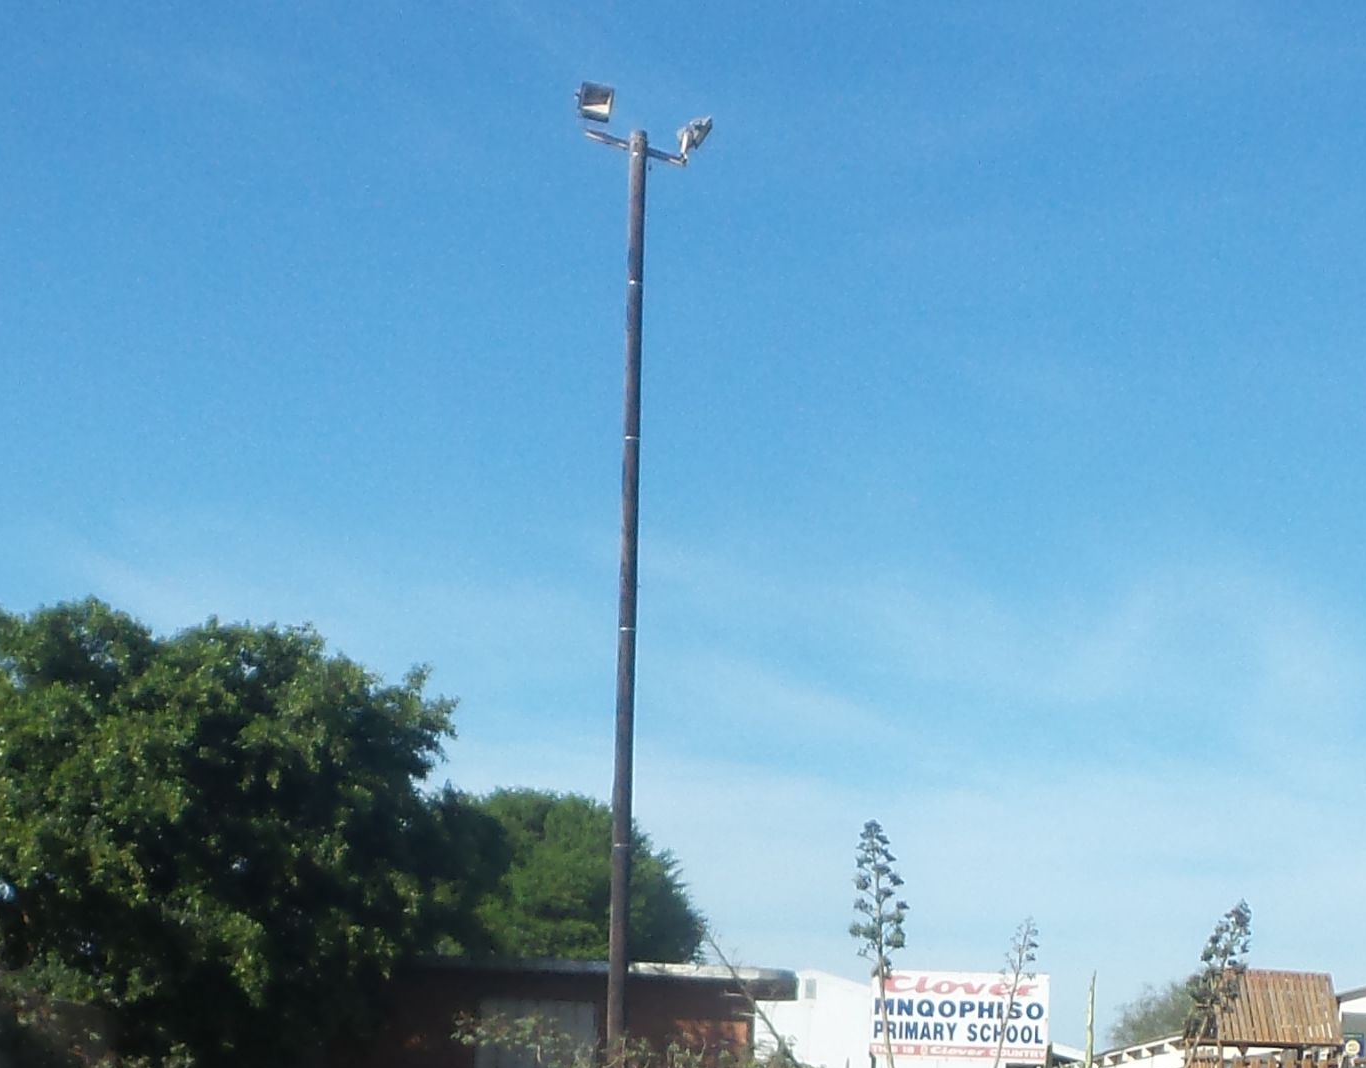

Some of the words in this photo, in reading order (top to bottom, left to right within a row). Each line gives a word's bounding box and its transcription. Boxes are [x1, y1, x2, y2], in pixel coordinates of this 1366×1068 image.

[884, 975, 1039, 996] Clover
[873, 997, 1044, 1020] MNQOPHISO
[873, 1020, 957, 1041] PRIMARY
[967, 1023, 1043, 1044] SCHOOL
[871, 1044, 898, 1055] THS
